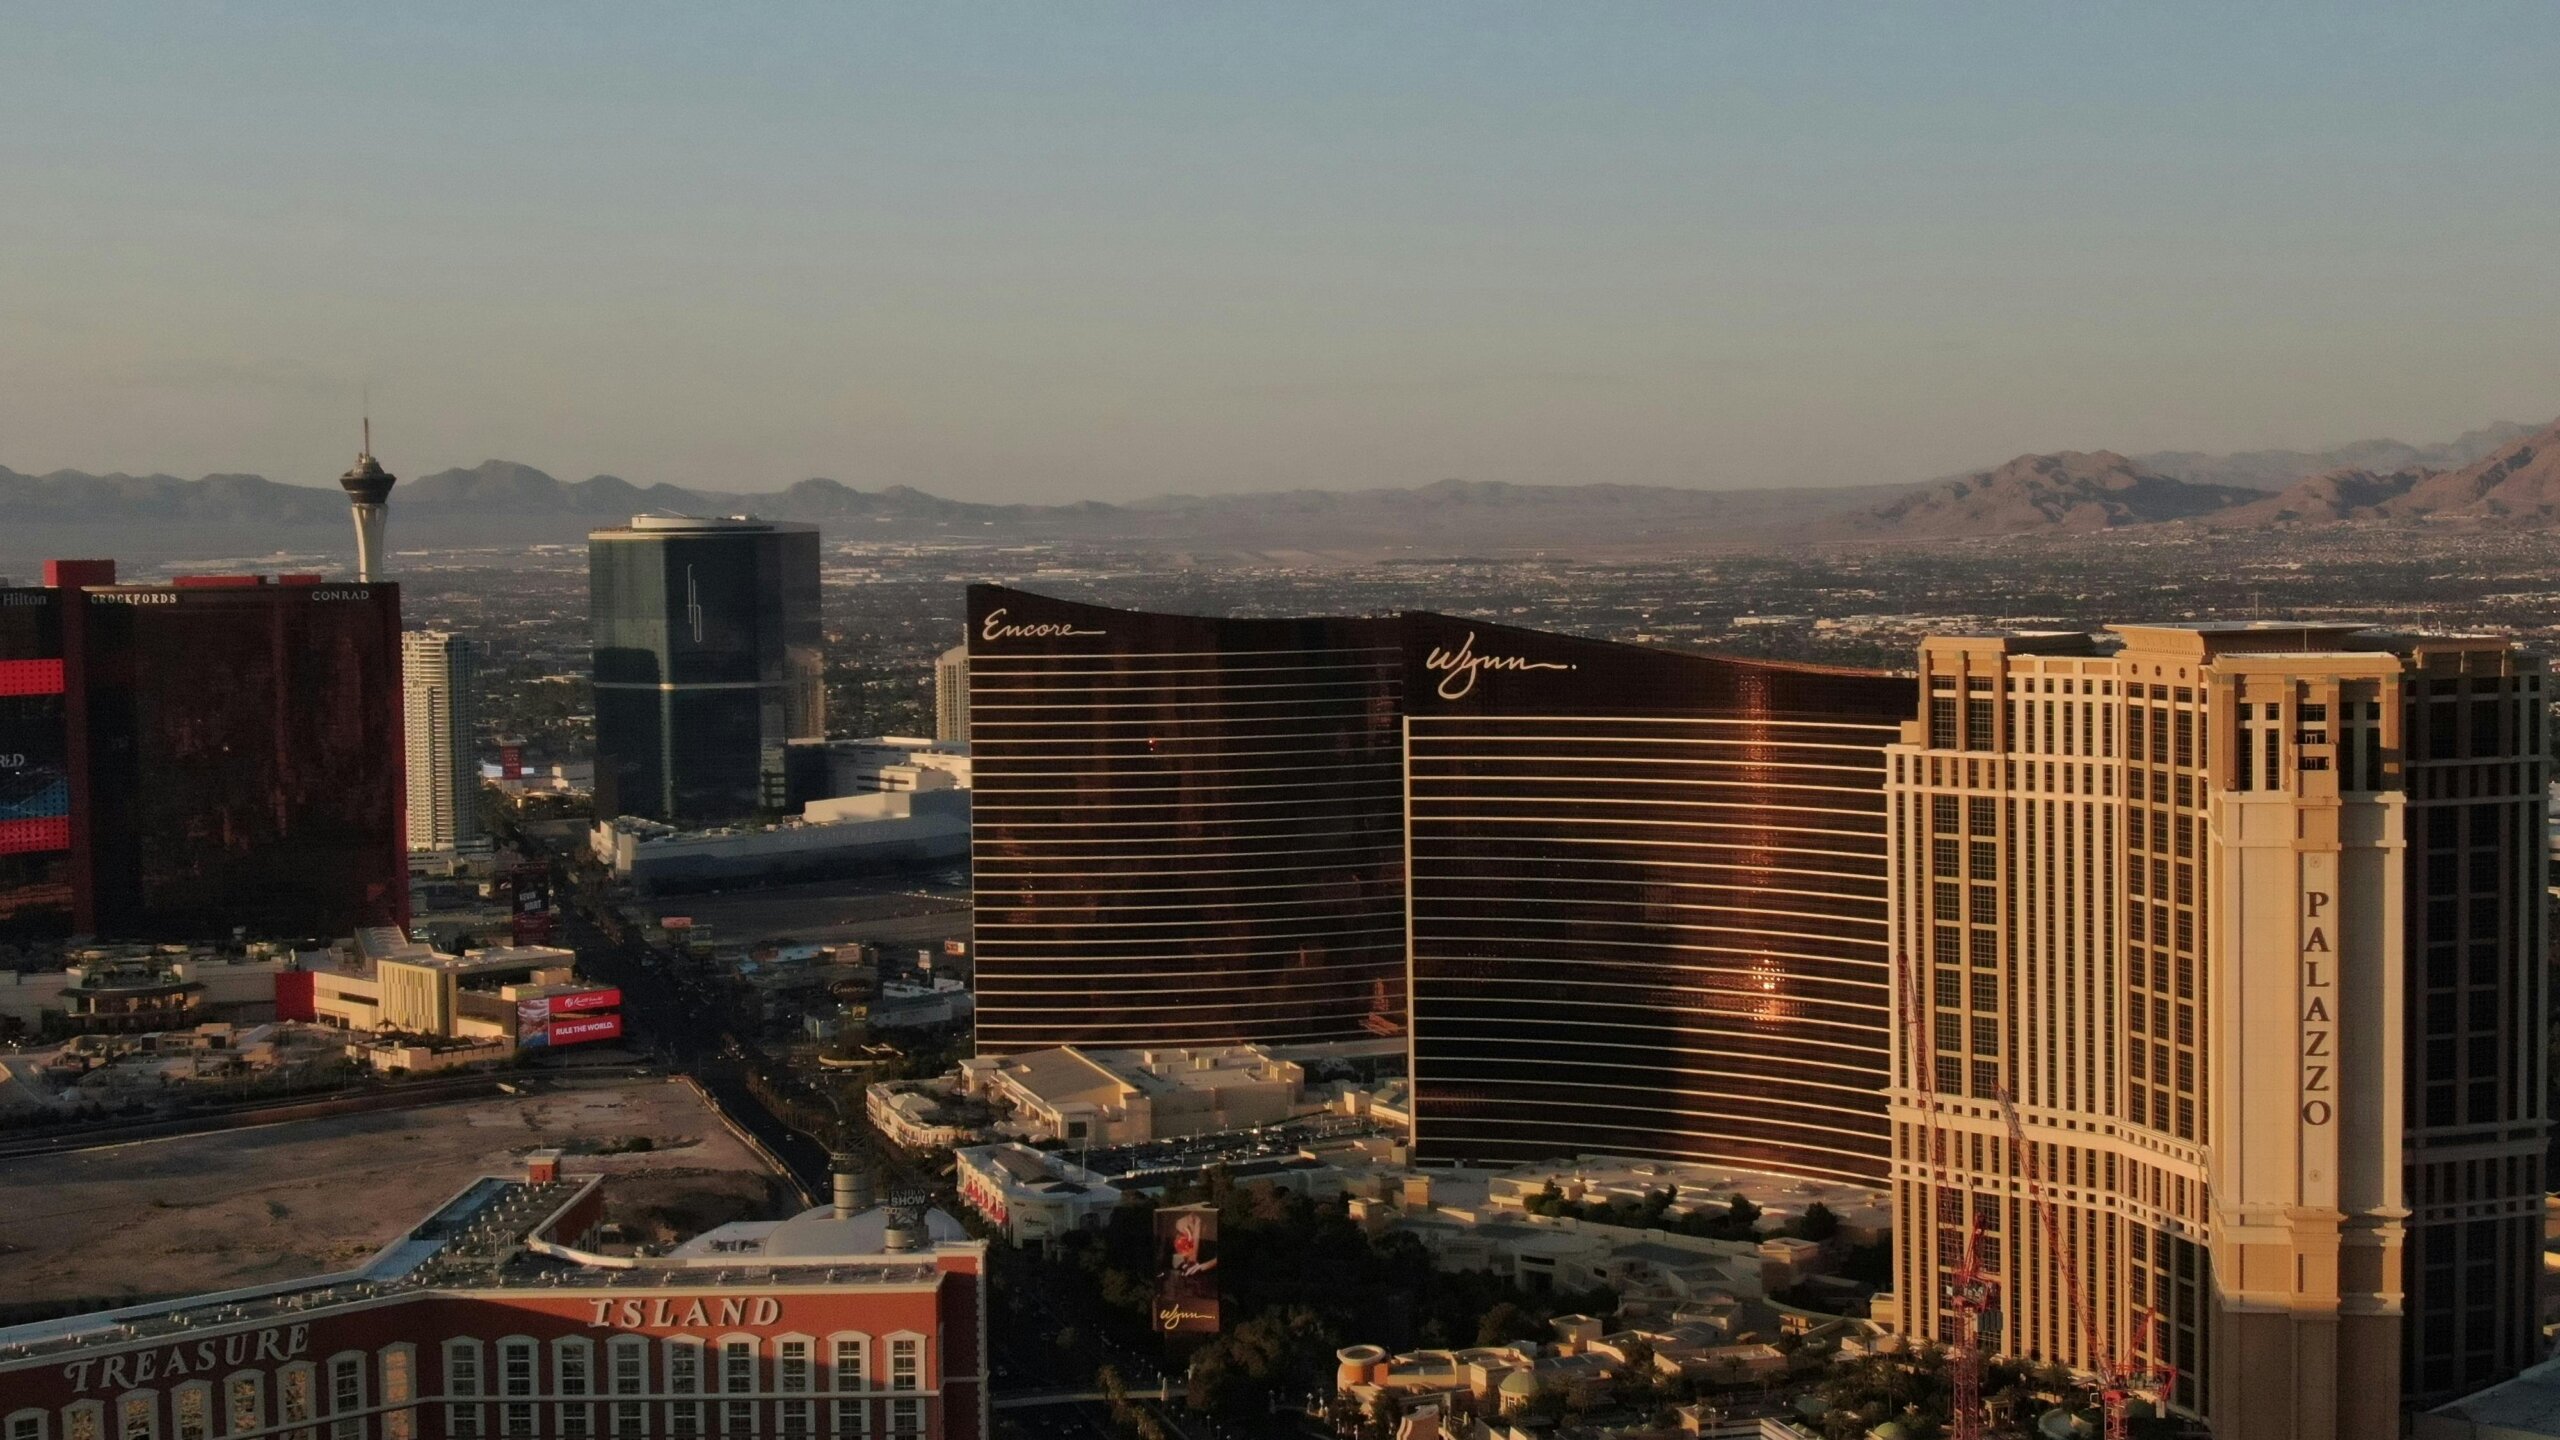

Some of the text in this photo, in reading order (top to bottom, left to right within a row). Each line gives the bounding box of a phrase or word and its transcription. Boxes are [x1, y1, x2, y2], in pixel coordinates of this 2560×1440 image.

[3, 592, 47, 606] Hilton
[91, 593, 177, 606] CROCKFORDS
[311, 590, 369, 601] CONRAD
[982, 607, 1106, 640] Encore
[2302, 891, 2331, 1126] PALAZZO
[555, 1026, 573, 1036] RULE
[573, 1025, 587, 1033] THE
[891, 1195, 926, 1206] SHOW
[587, 1297, 780, 1328] ISLAND
[63, 1323, 310, 1393] TREASURE
